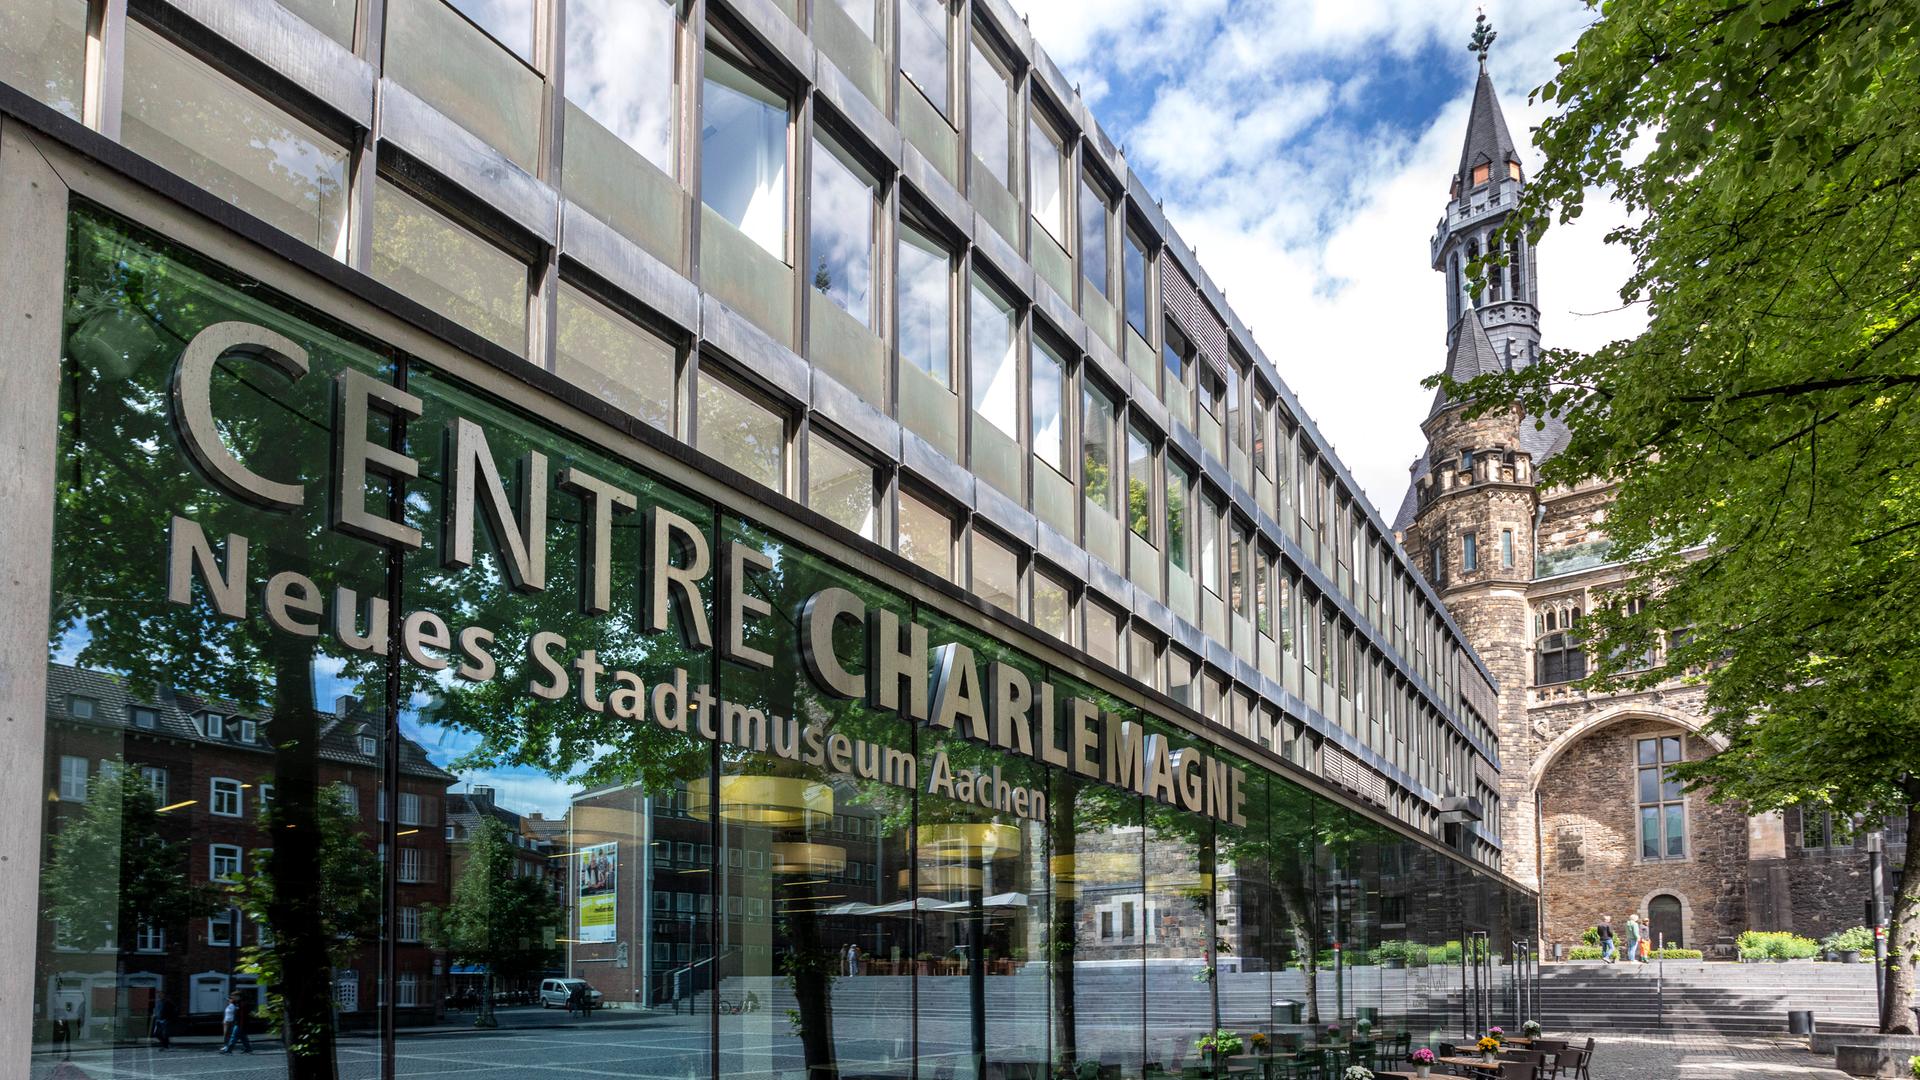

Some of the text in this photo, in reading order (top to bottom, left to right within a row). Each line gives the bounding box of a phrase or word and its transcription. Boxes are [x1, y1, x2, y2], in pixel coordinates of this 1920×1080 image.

[167, 515, 1047, 822] Neues Stadtmuseum Aachen
[171, 320, 1247, 829] CENTRE CHARLEMAGNE
